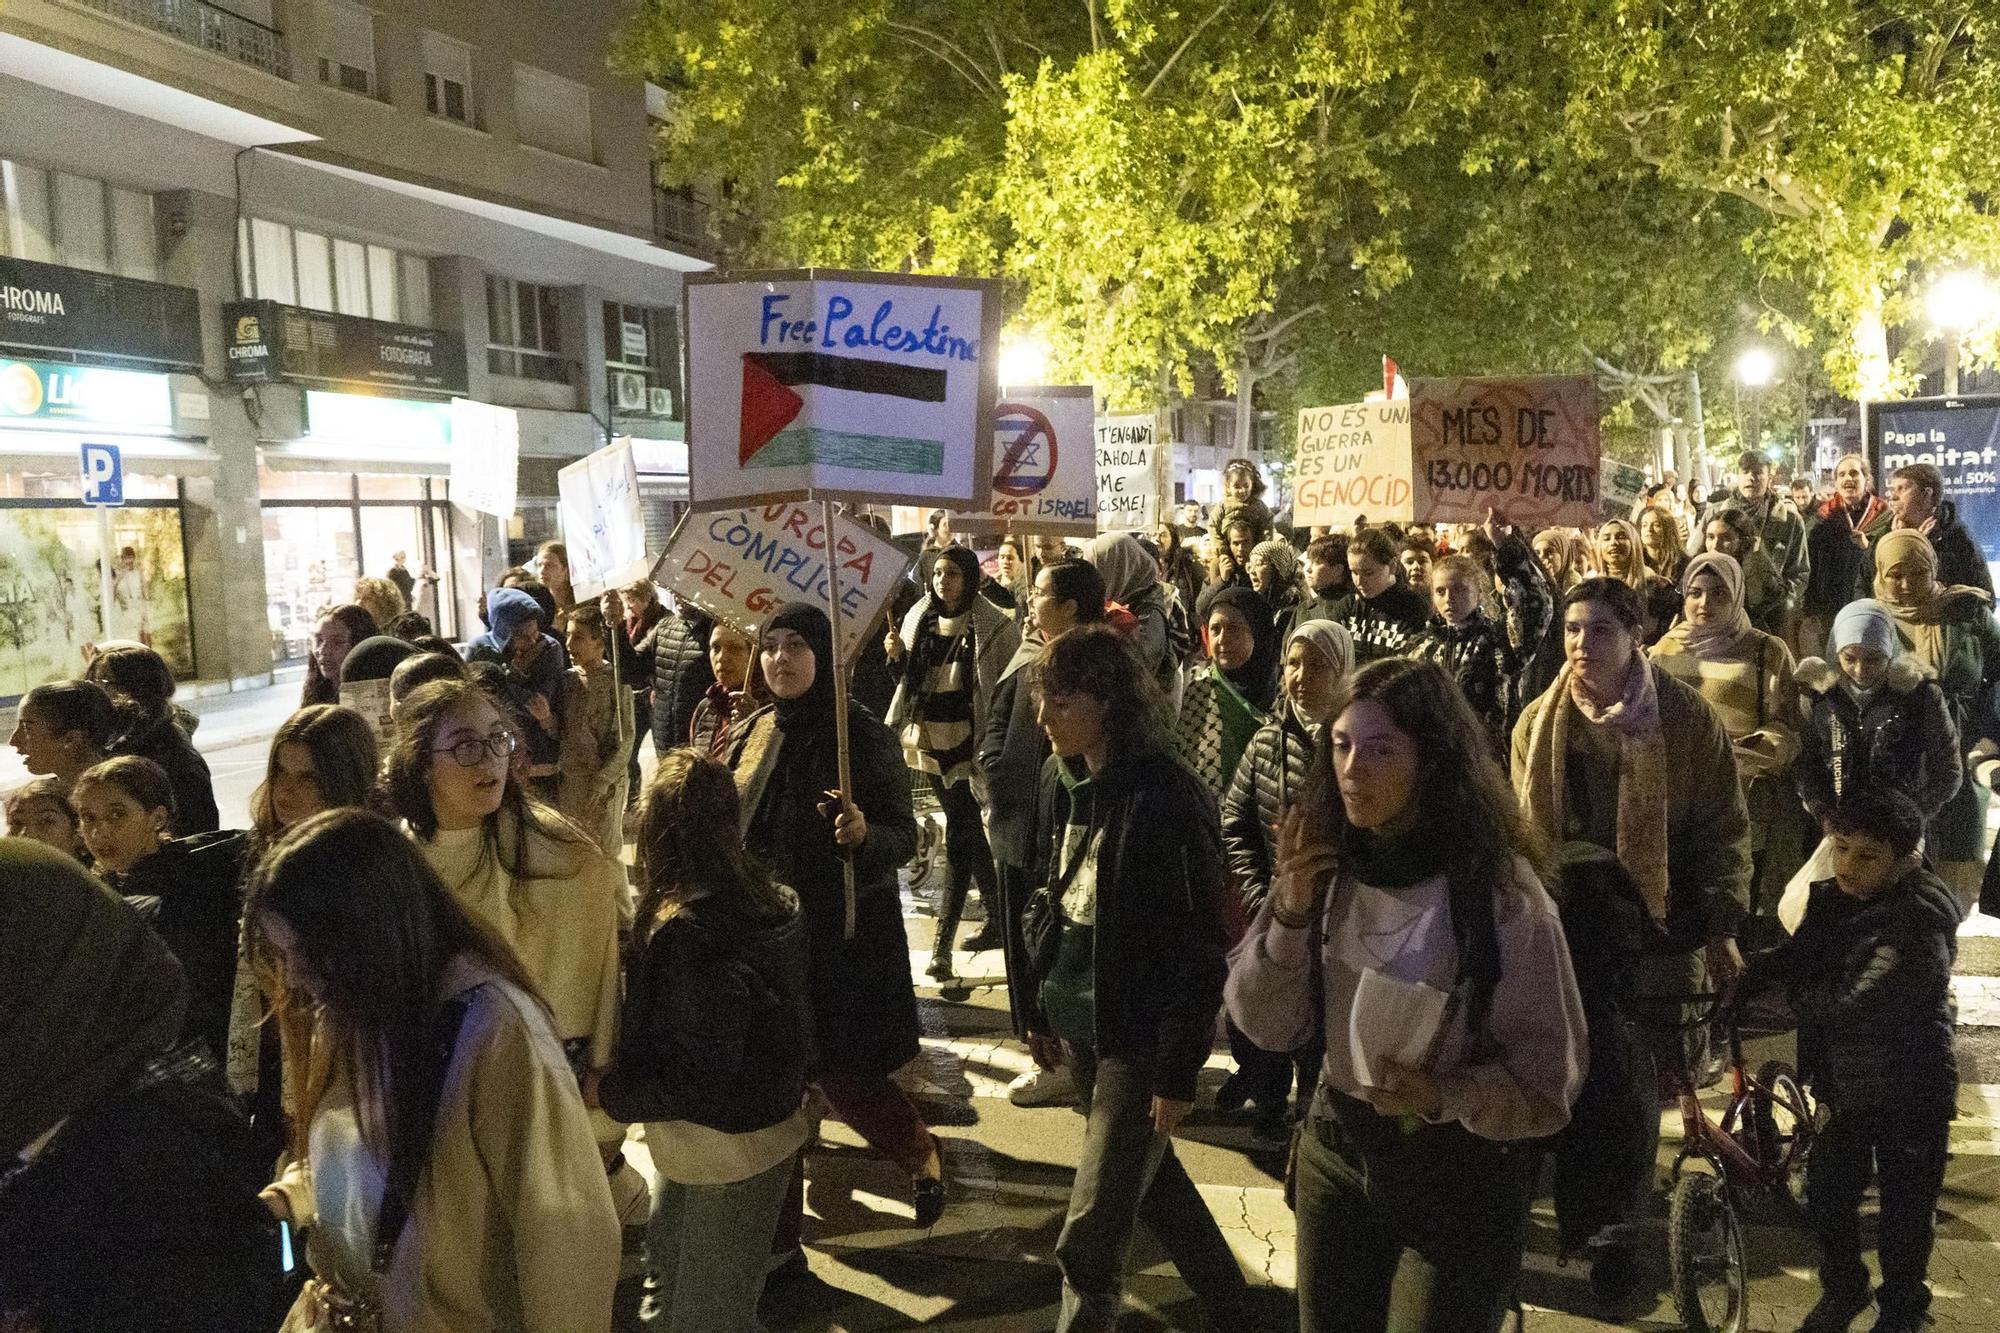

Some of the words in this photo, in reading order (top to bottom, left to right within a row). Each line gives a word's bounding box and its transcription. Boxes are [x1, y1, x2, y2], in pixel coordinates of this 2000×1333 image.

[761, 294, 818, 346] Free
[229, 344, 269, 359] CHROMA
[1302, 412, 1333, 433] NO
[1341, 404, 1369, 428] ÉS
[1379, 406, 1410, 424] UN
[1442, 401, 1502, 446] MÉS
[1516, 407, 1556, 449] DE
[1301, 430, 1374, 454] GUERRA
[1884, 431, 1927, 447] Paga
[1930, 428, 1946, 443] la
[1299, 456, 1325, 476] ES
[1333, 454, 1363, 473] UN
[1884, 444, 1998, 469] meitat
[87, 448, 114, 498] P
[1427, 459, 1513, 492] 13.000
[1520, 461, 1597, 504] MORTS
[1965, 471, 1997, 485] 50%
[1097, 494, 1146, 514] CISME!
[750, 501, 874, 585] UROPA
[682, 550, 737, 600] DEL
[708, 511, 869, 620] CÒMPLICE
